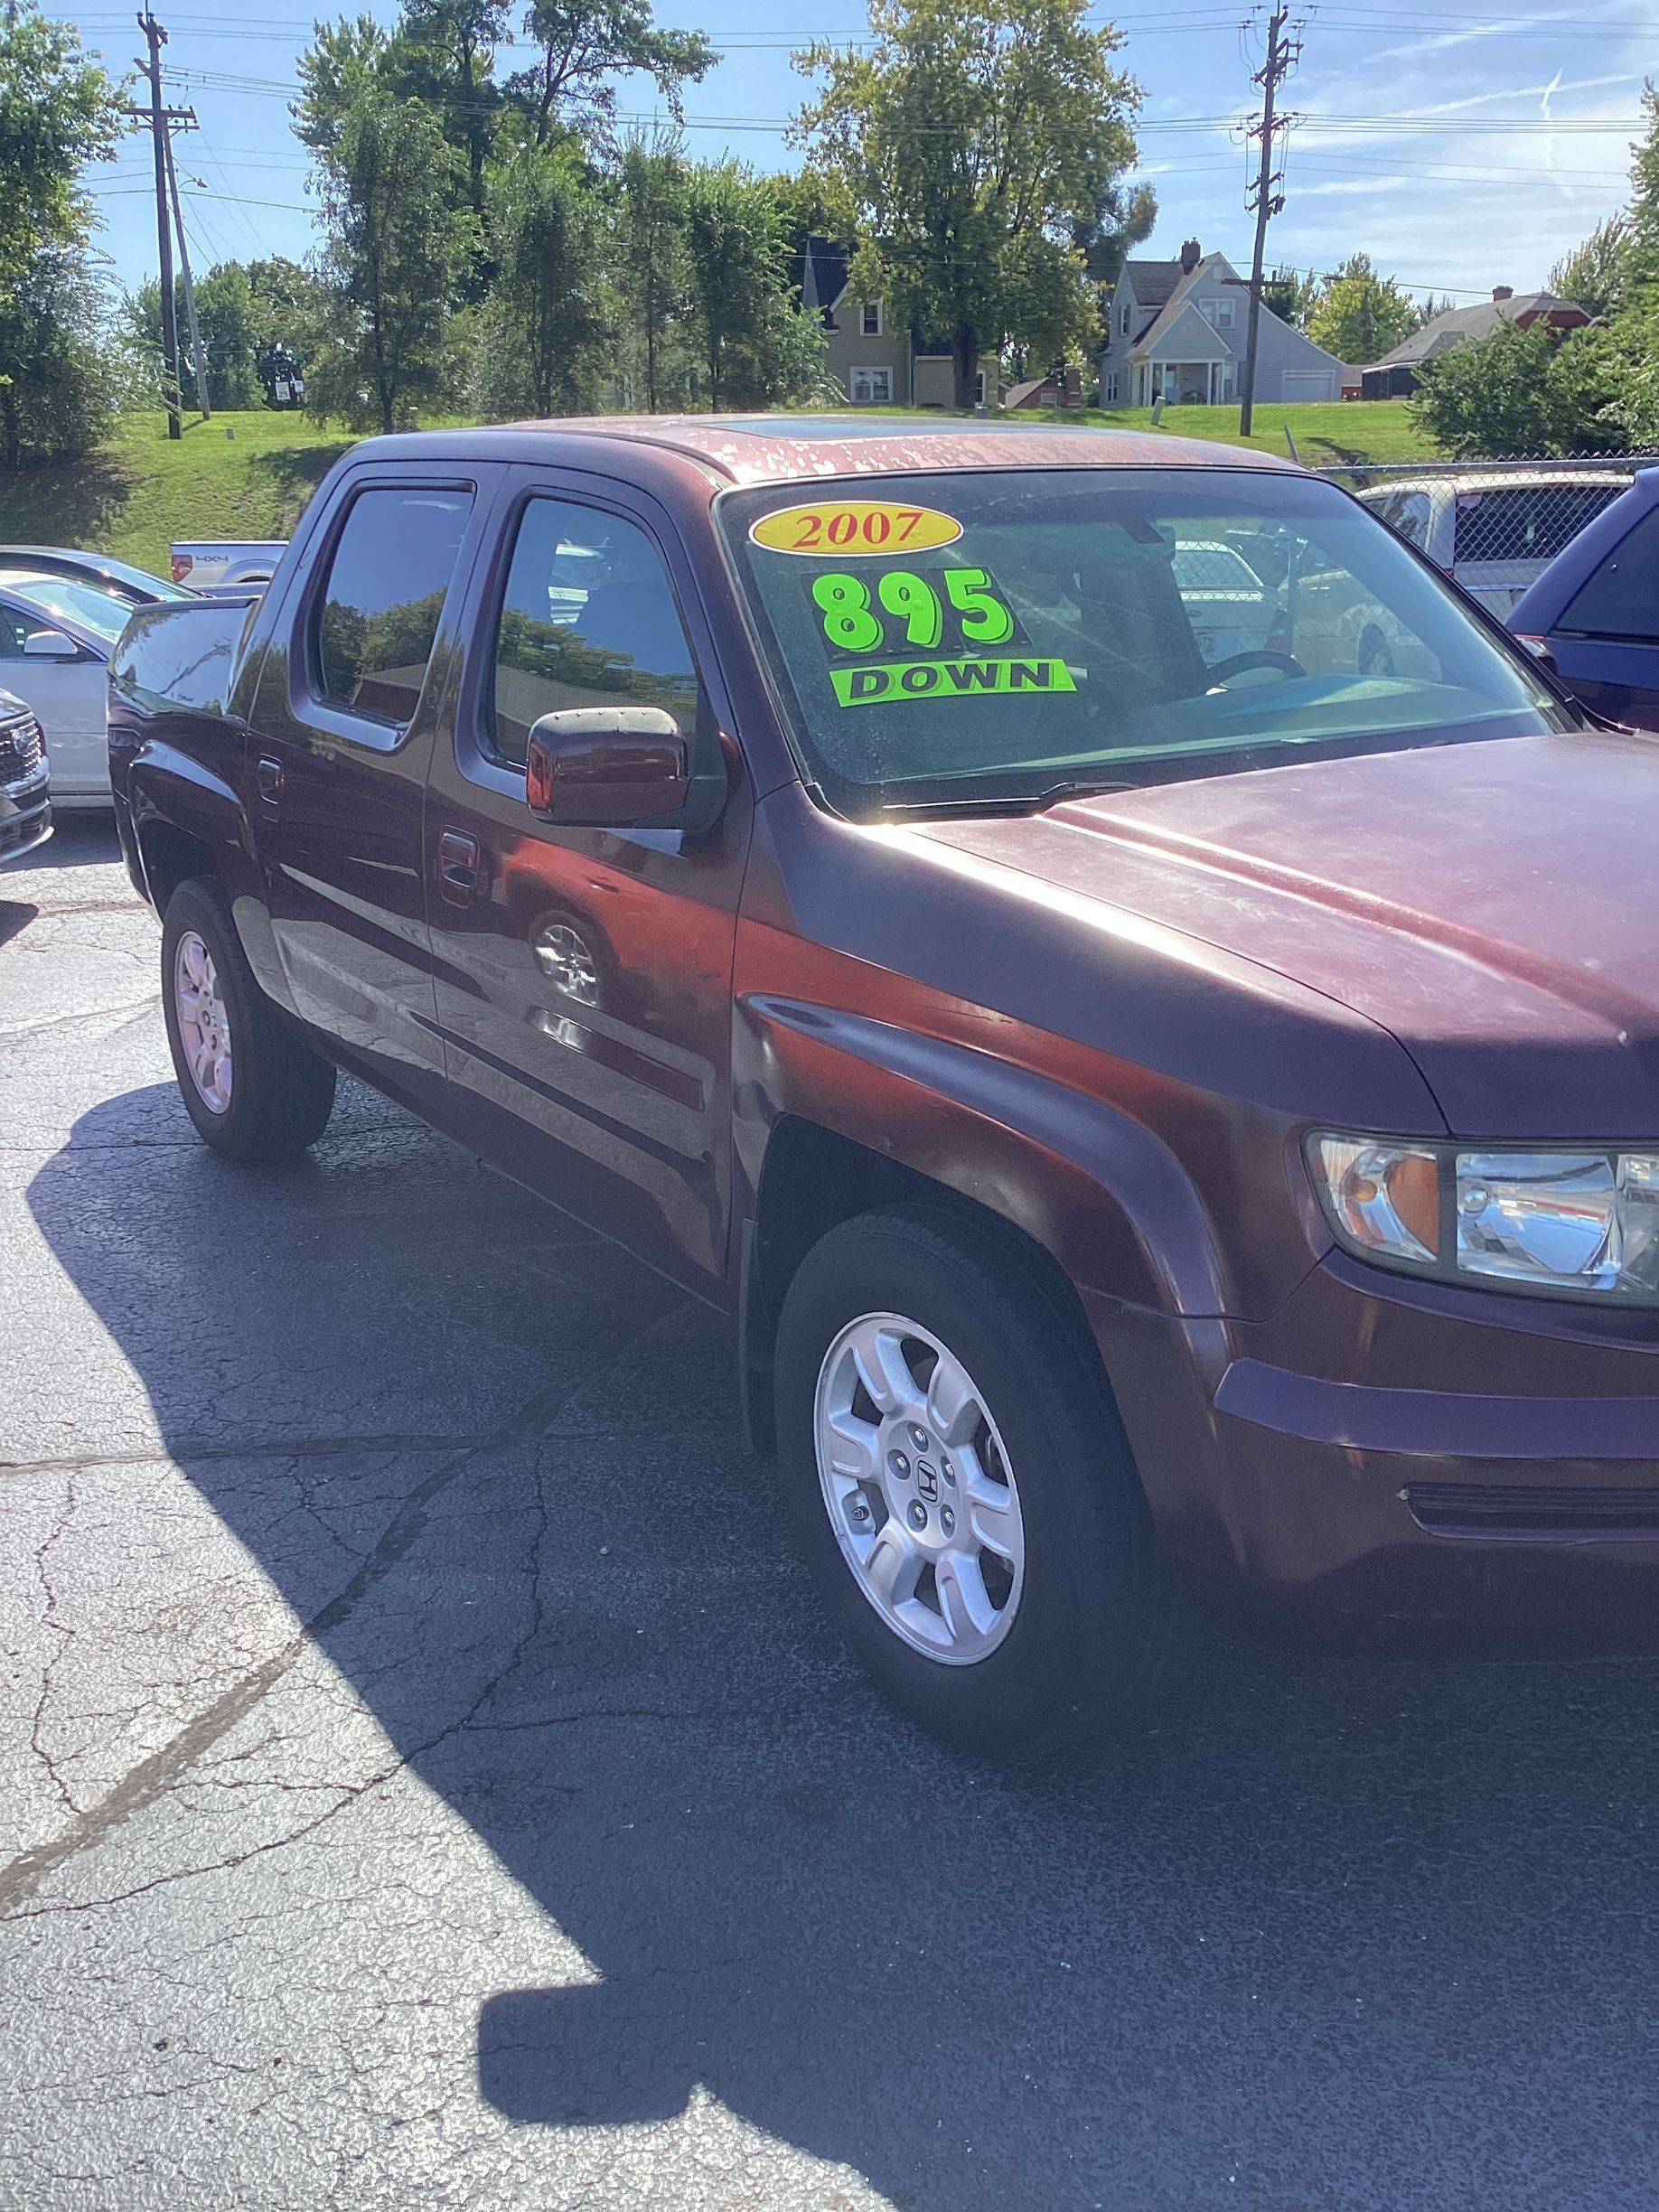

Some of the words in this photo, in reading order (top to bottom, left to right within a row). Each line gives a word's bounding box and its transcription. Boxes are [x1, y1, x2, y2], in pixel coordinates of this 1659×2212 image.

[278, 390, 289, 398] 25
[792, 511, 924, 548] 2007
[812, 569, 1015, 652] 895
[849, 661, 1055, 699] DOWN
